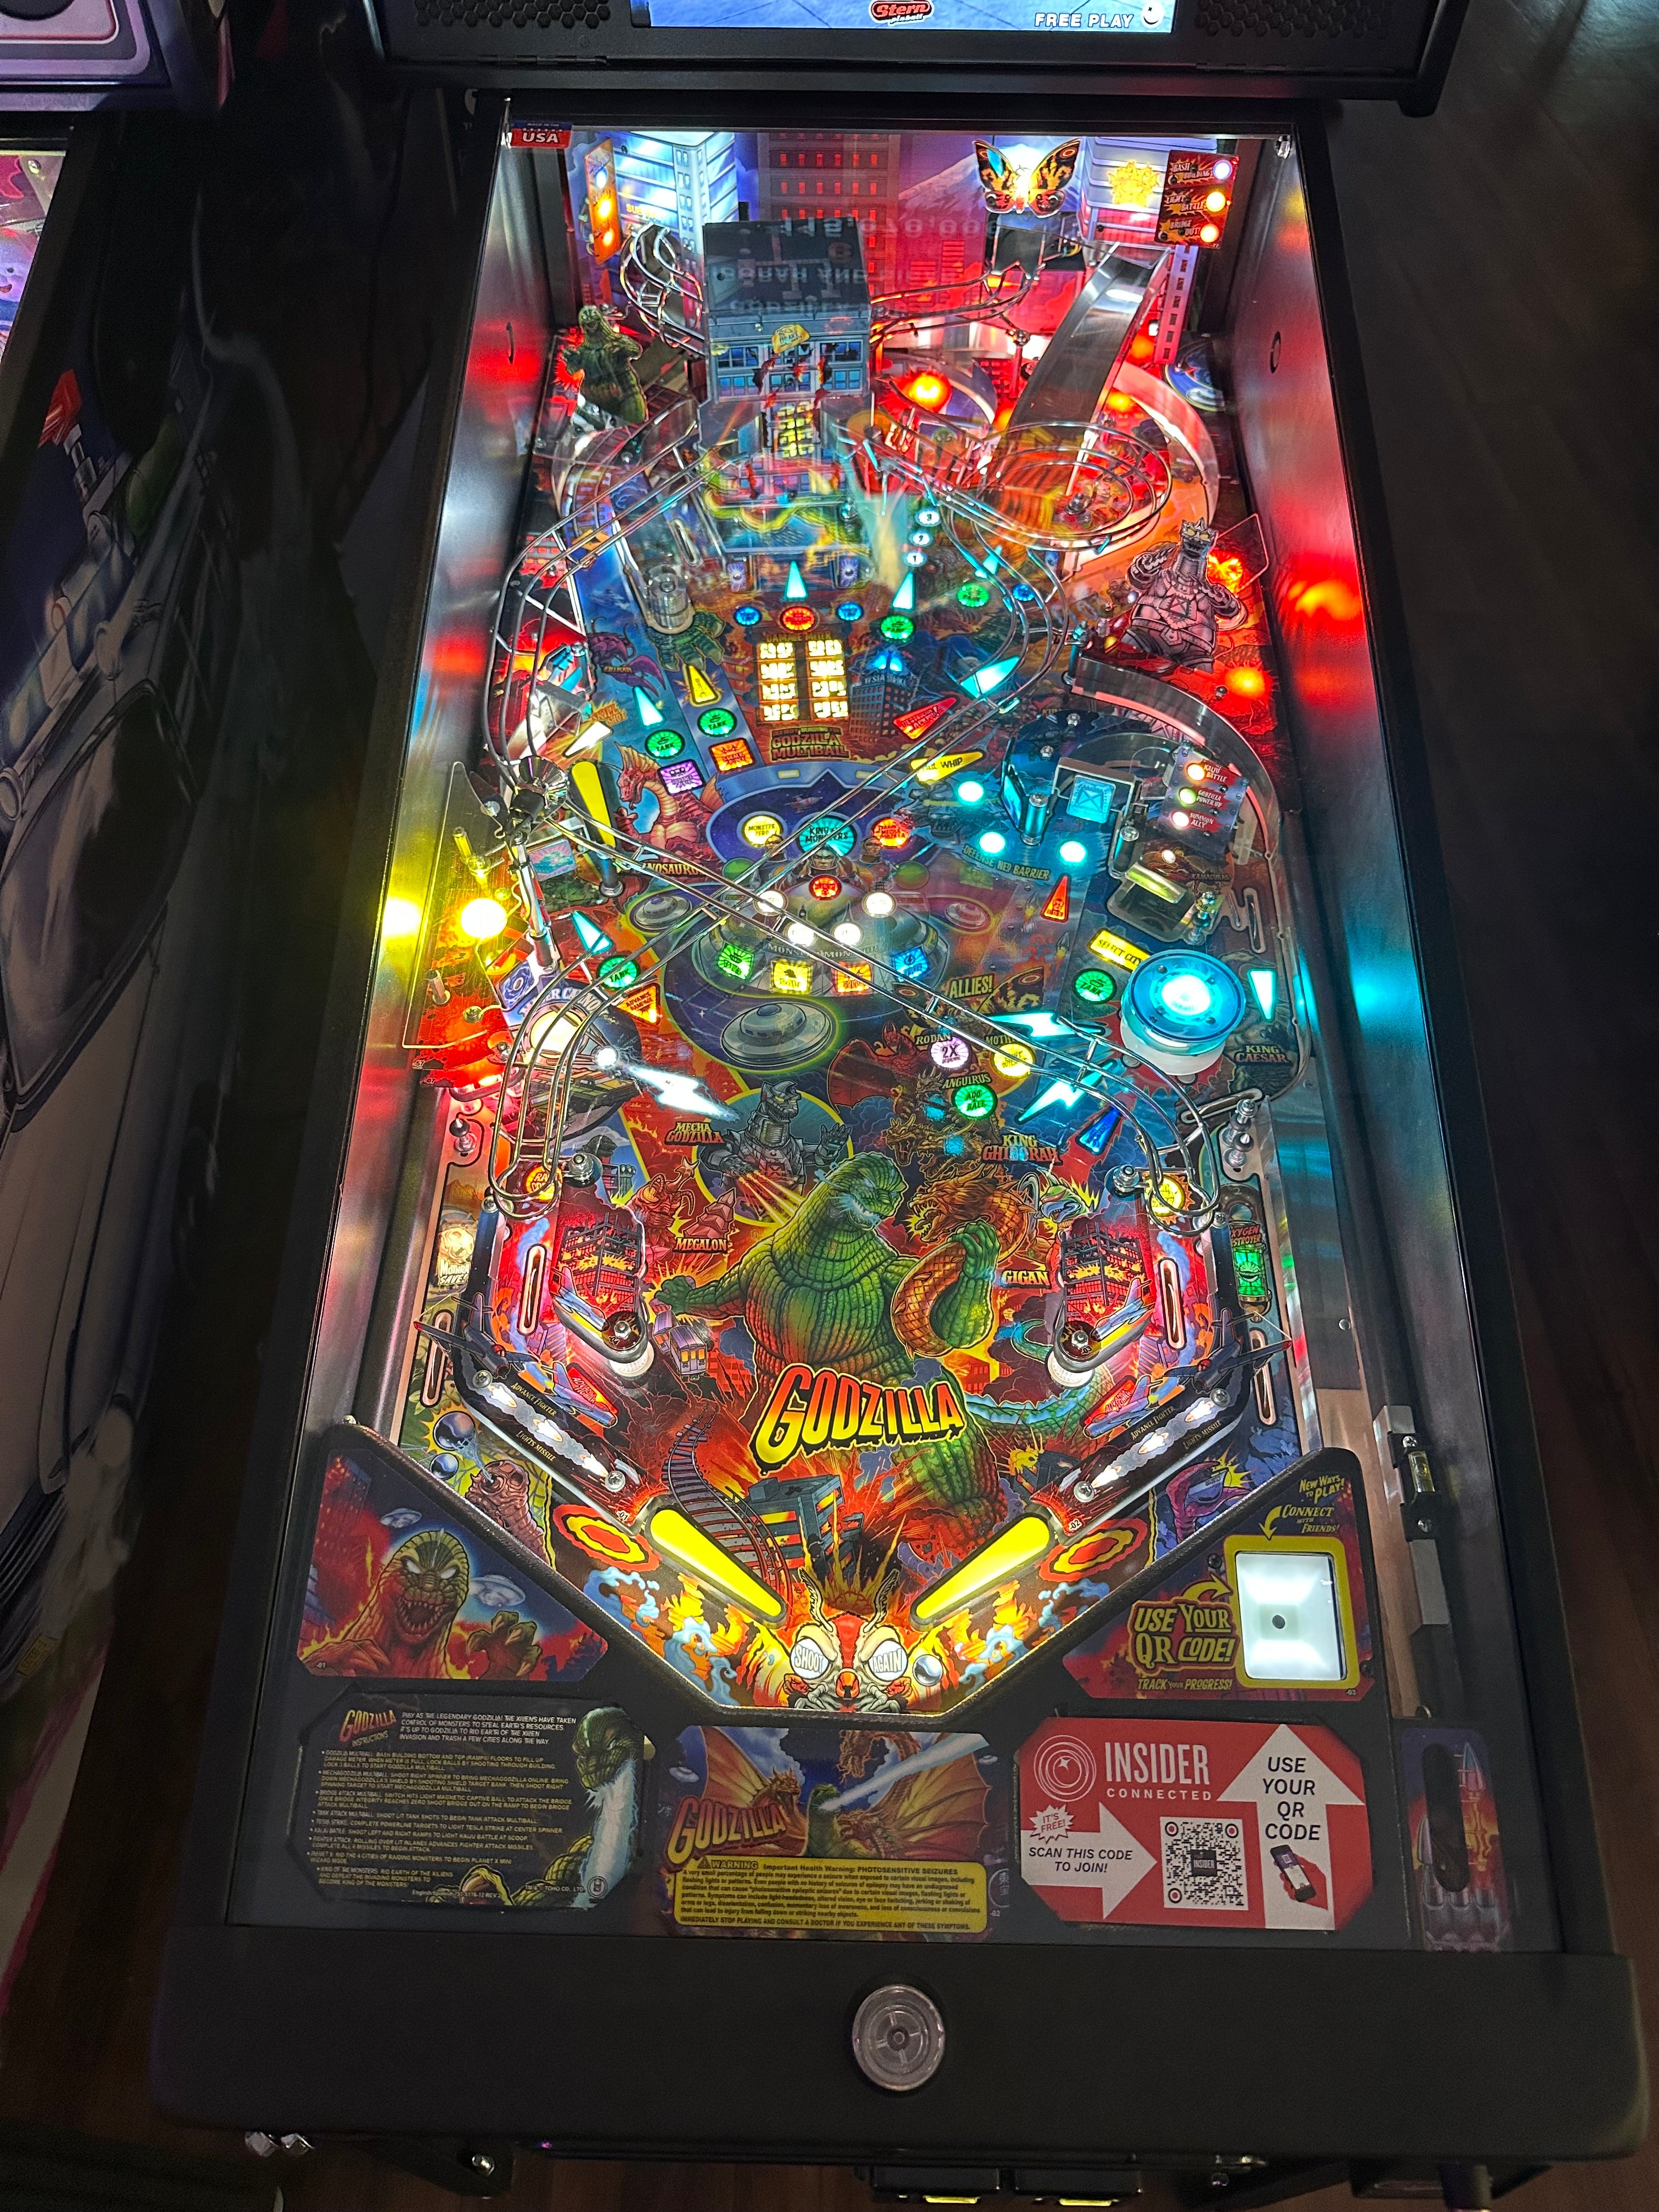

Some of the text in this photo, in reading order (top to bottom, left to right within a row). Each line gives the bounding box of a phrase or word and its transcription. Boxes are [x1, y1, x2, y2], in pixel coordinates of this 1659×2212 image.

[1035, 14, 1134, 29] FREE PLAY
[523, 132, 558, 143] USA
[592, 704, 616, 721] SKILL
[607, 712, 627, 725] SHOT
[708, 720, 727, 729] TANK
[656, 743, 675, 751] TANK
[772, 732, 840, 748] GODZILLA
[772, 745, 849, 759] MULTIBALL
[940, 757, 963, 769] WHIP
[1203, 764, 1221, 774] KAIJU
[1206, 771, 1227, 783] BATTLE
[1196, 795, 1214, 806] POWER
[1198, 789, 1221, 802] GODZILLA
[1190, 812, 1214, 825] SUMMON
[1190, 819, 1207, 828] ALLY
[963, 844, 994, 867] DEFENSE
[1012, 864, 1050, 880] BARRIER
[1098, 939, 1125, 957] SELECT
[610, 968, 631, 983] TANK
[949, 975, 993, 998] ALLIES!
[1080, 983, 1104, 997] TANK
[625, 991, 652, 1007] ADVANCE
[916, 1034, 952, 1045] RODAN
[942, 1044, 959, 1058] 2X
[1245, 1045, 1279, 1054] KING
[1235, 1052, 1287, 1063] CAESAR
[941, 1073, 991, 1090] ANGUIRUS
[965, 1090, 981, 1100] ADD
[967, 1099, 987, 1111] BALL
[675, 1122, 711, 1132] MECHA
[666, 1130, 724, 1143] GODZILLA
[1003, 1135, 1038, 1147] KING
[982, 1146, 1060, 1162] GHIDORAH
[1231, 1225, 1260, 1238] XYGEN
[675, 1238, 727, 1251] MEGALON
[439, 1258, 470, 1277] MOTHRA
[439, 1274, 469, 1284] SAVE!
[1002, 1271, 1048, 1285] GIGAN
[511, 1383, 558, 1417] ADVANCE FIGHTER
[755, 1366, 966, 1464] GODZILLA
[1130, 1406, 1176, 1441] ADVANCE FIGHTER
[1182, 1420, 1222, 1451] LIGHTS MISSILE
[516, 1431, 556, 1462] LIGHTS MISSILE
[1299, 1475, 1341, 1492] NEW WAYS
[1314, 1477, 1345, 1504] PLAY!
[1281, 1504, 1334, 1519] CONNECT
[1301, 1523, 1340, 1533] FRIENDS!
[1134, 1604, 1232, 1633] USE YOUR
[794, 1644, 824, 1673] SHOOT
[1135, 1634, 1236, 1669] QR CODE!
[872, 1648, 902, 1673] AGAIN
[1137, 1679, 1166, 1690] TRACK
[1184, 1679, 1233, 1690] PROGRESS!
[340, 1709, 397, 1743] GODZILLA
[352, 1730, 389, 1747] INSTRUCTIONS
[1104, 1741, 1210, 1785] INSIDER
[1267, 1757, 1306, 1774] USE
[1262, 1778, 1316, 1795] YOUR
[1106, 1788, 1211, 1801] CONNECTED
[1277, 1801, 1305, 1821] QR
[1042, 1813, 1059, 1824] IT'S
[667, 1798, 787, 1864] GODZILLA
[1040, 1819, 1066, 1833] FREE!
[1265, 1824, 1321, 1841] CODE
[1029, 1847, 1133, 1860] SCAN THIS CODE
[712, 1859, 759, 1870] WARNING
[825, 1865, 855, 1874] Warning:
[1054, 1861, 1108, 1873] TO JOIN!
[1193, 1858, 1215, 1869] INSIDER
